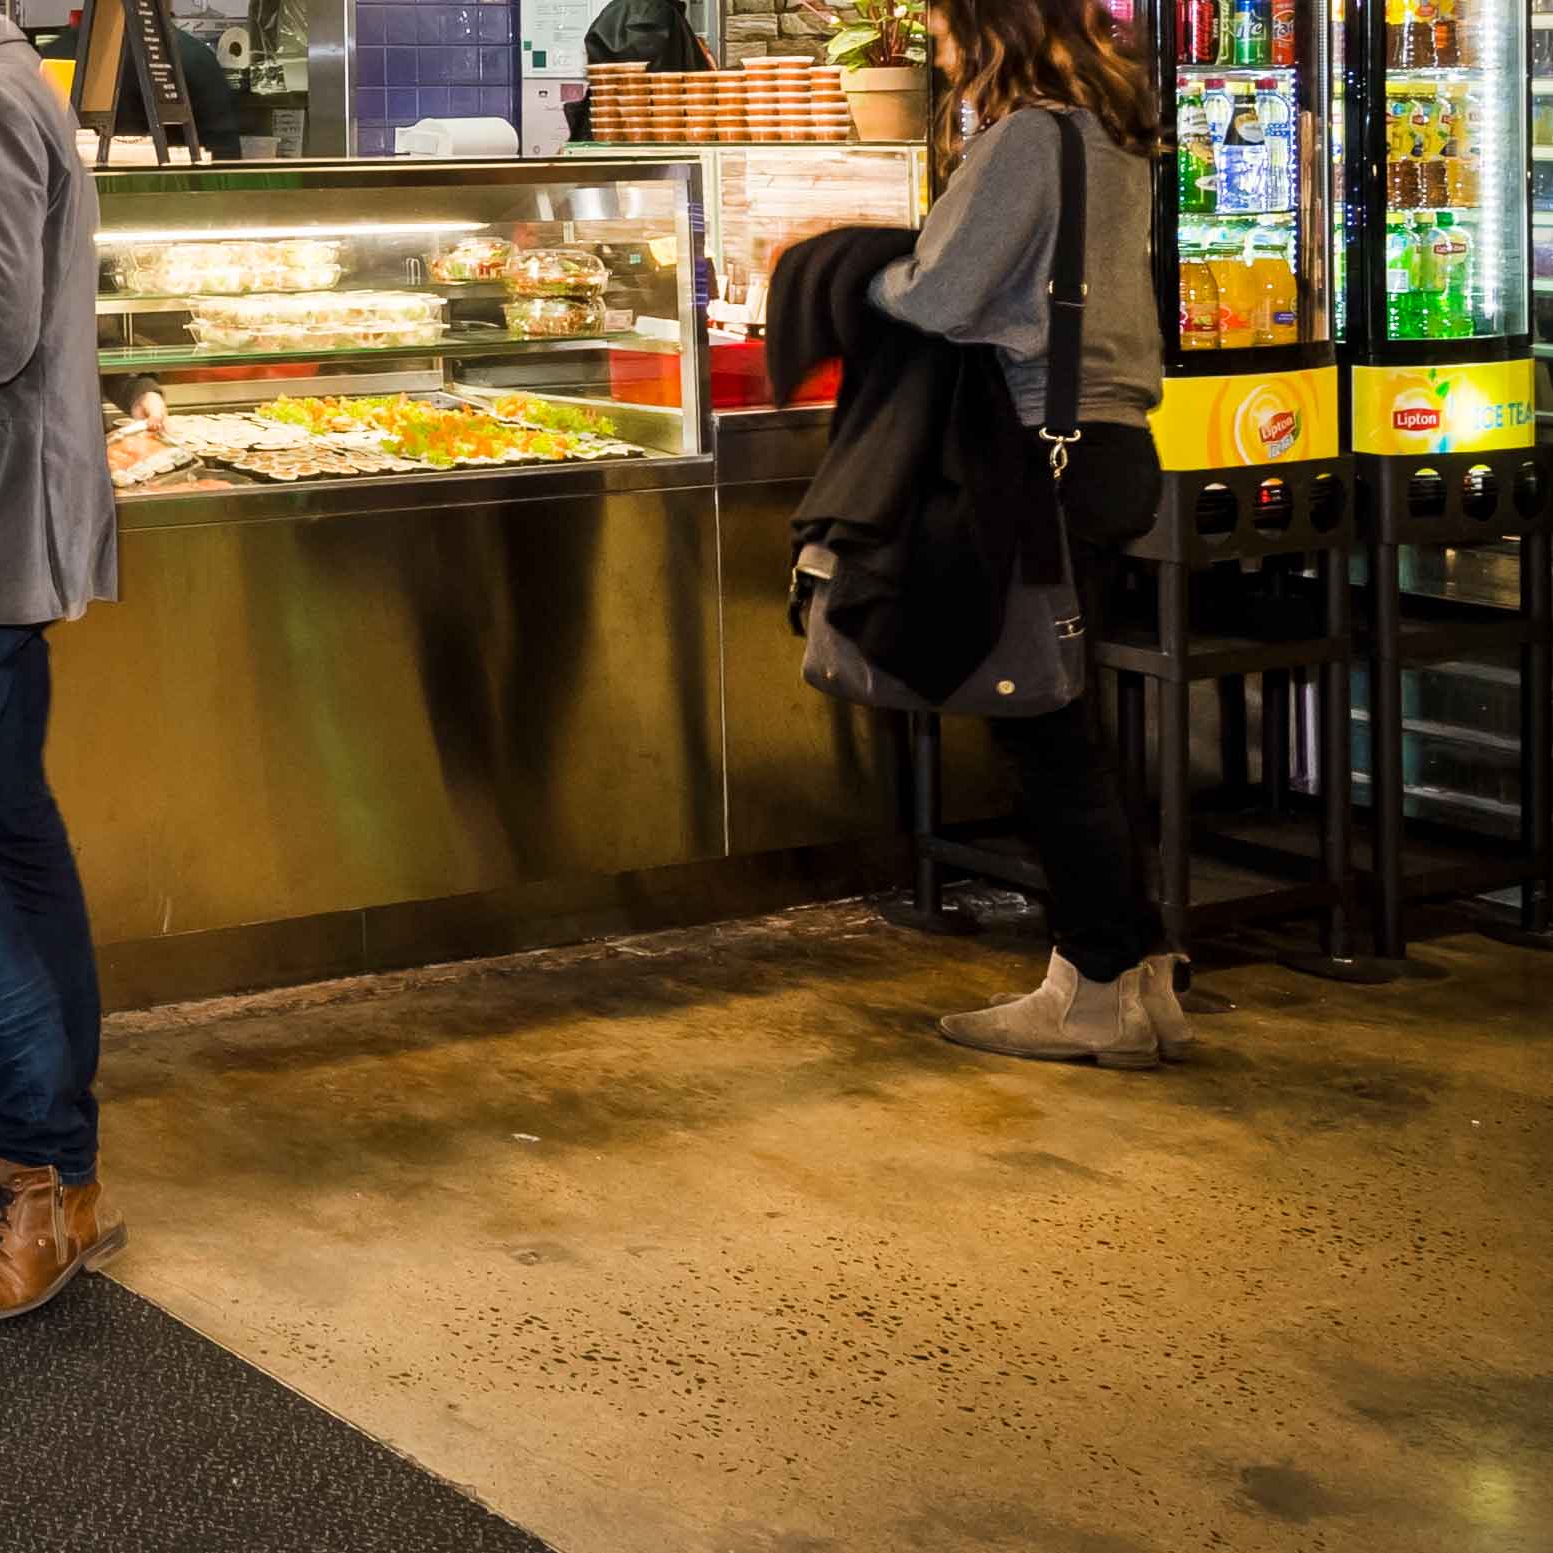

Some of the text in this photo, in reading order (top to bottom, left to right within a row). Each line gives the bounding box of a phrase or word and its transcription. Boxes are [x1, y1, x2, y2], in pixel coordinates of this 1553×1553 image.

[1396, 412, 1437, 428] Lipton
[1508, 400, 1534, 425] TEA
[1261, 414, 1294, 439] Lipton
